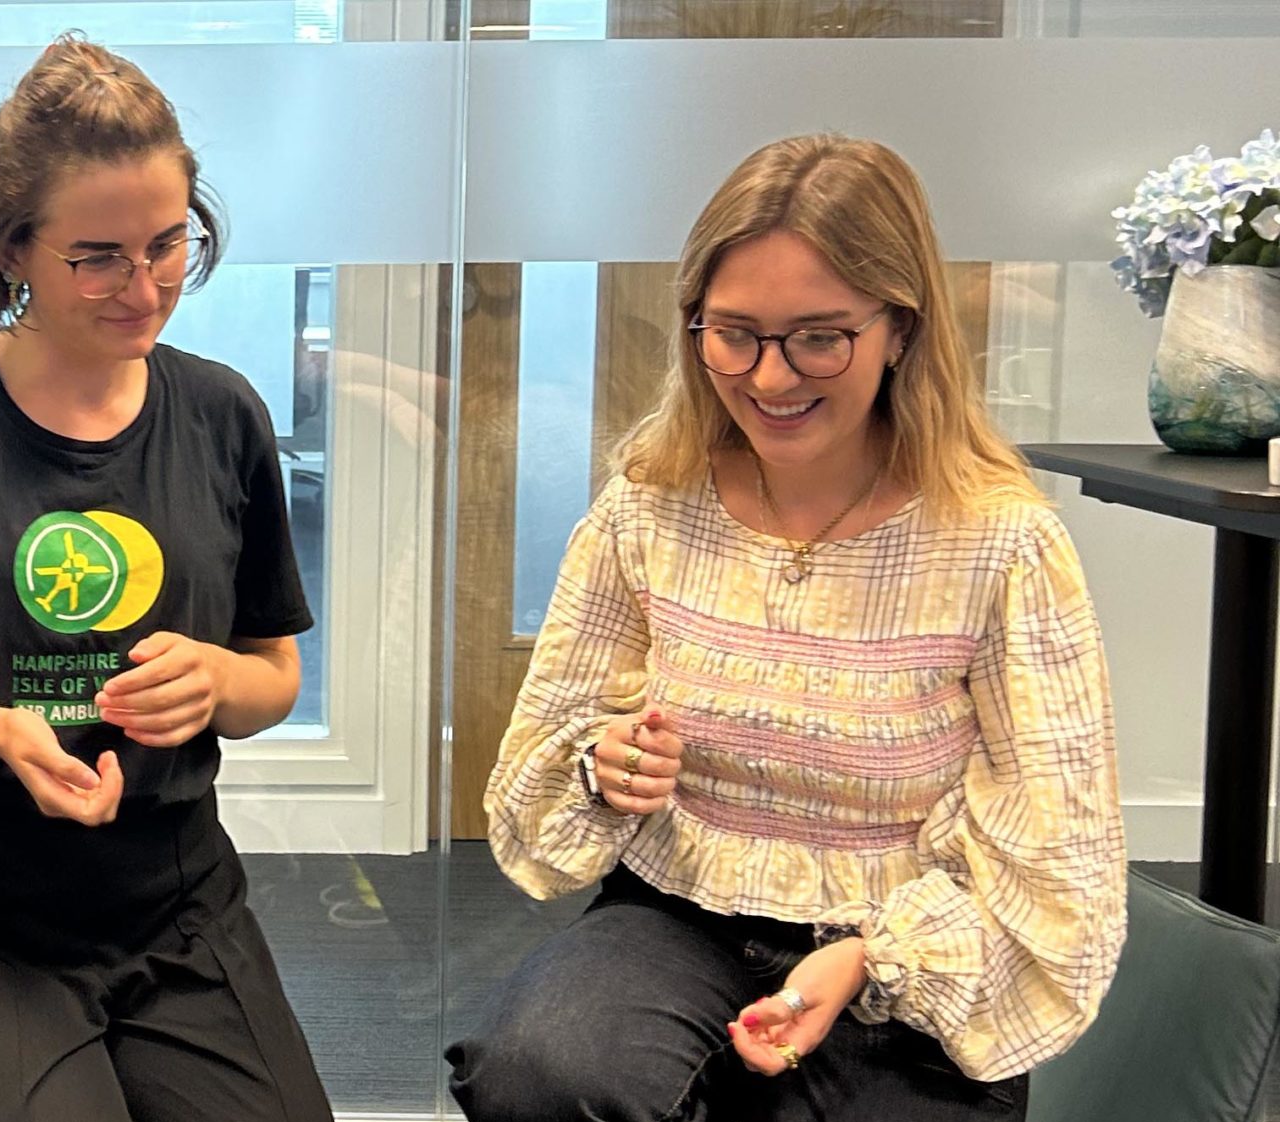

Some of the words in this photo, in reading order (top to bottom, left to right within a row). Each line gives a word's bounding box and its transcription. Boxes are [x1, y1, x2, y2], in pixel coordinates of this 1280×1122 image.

[12, 653, 120, 671] HAMPSHIRE
[12, 677, 55, 694] ISLE
[61, 677, 88, 695] OF
[49, 703, 101, 721] AMBU
